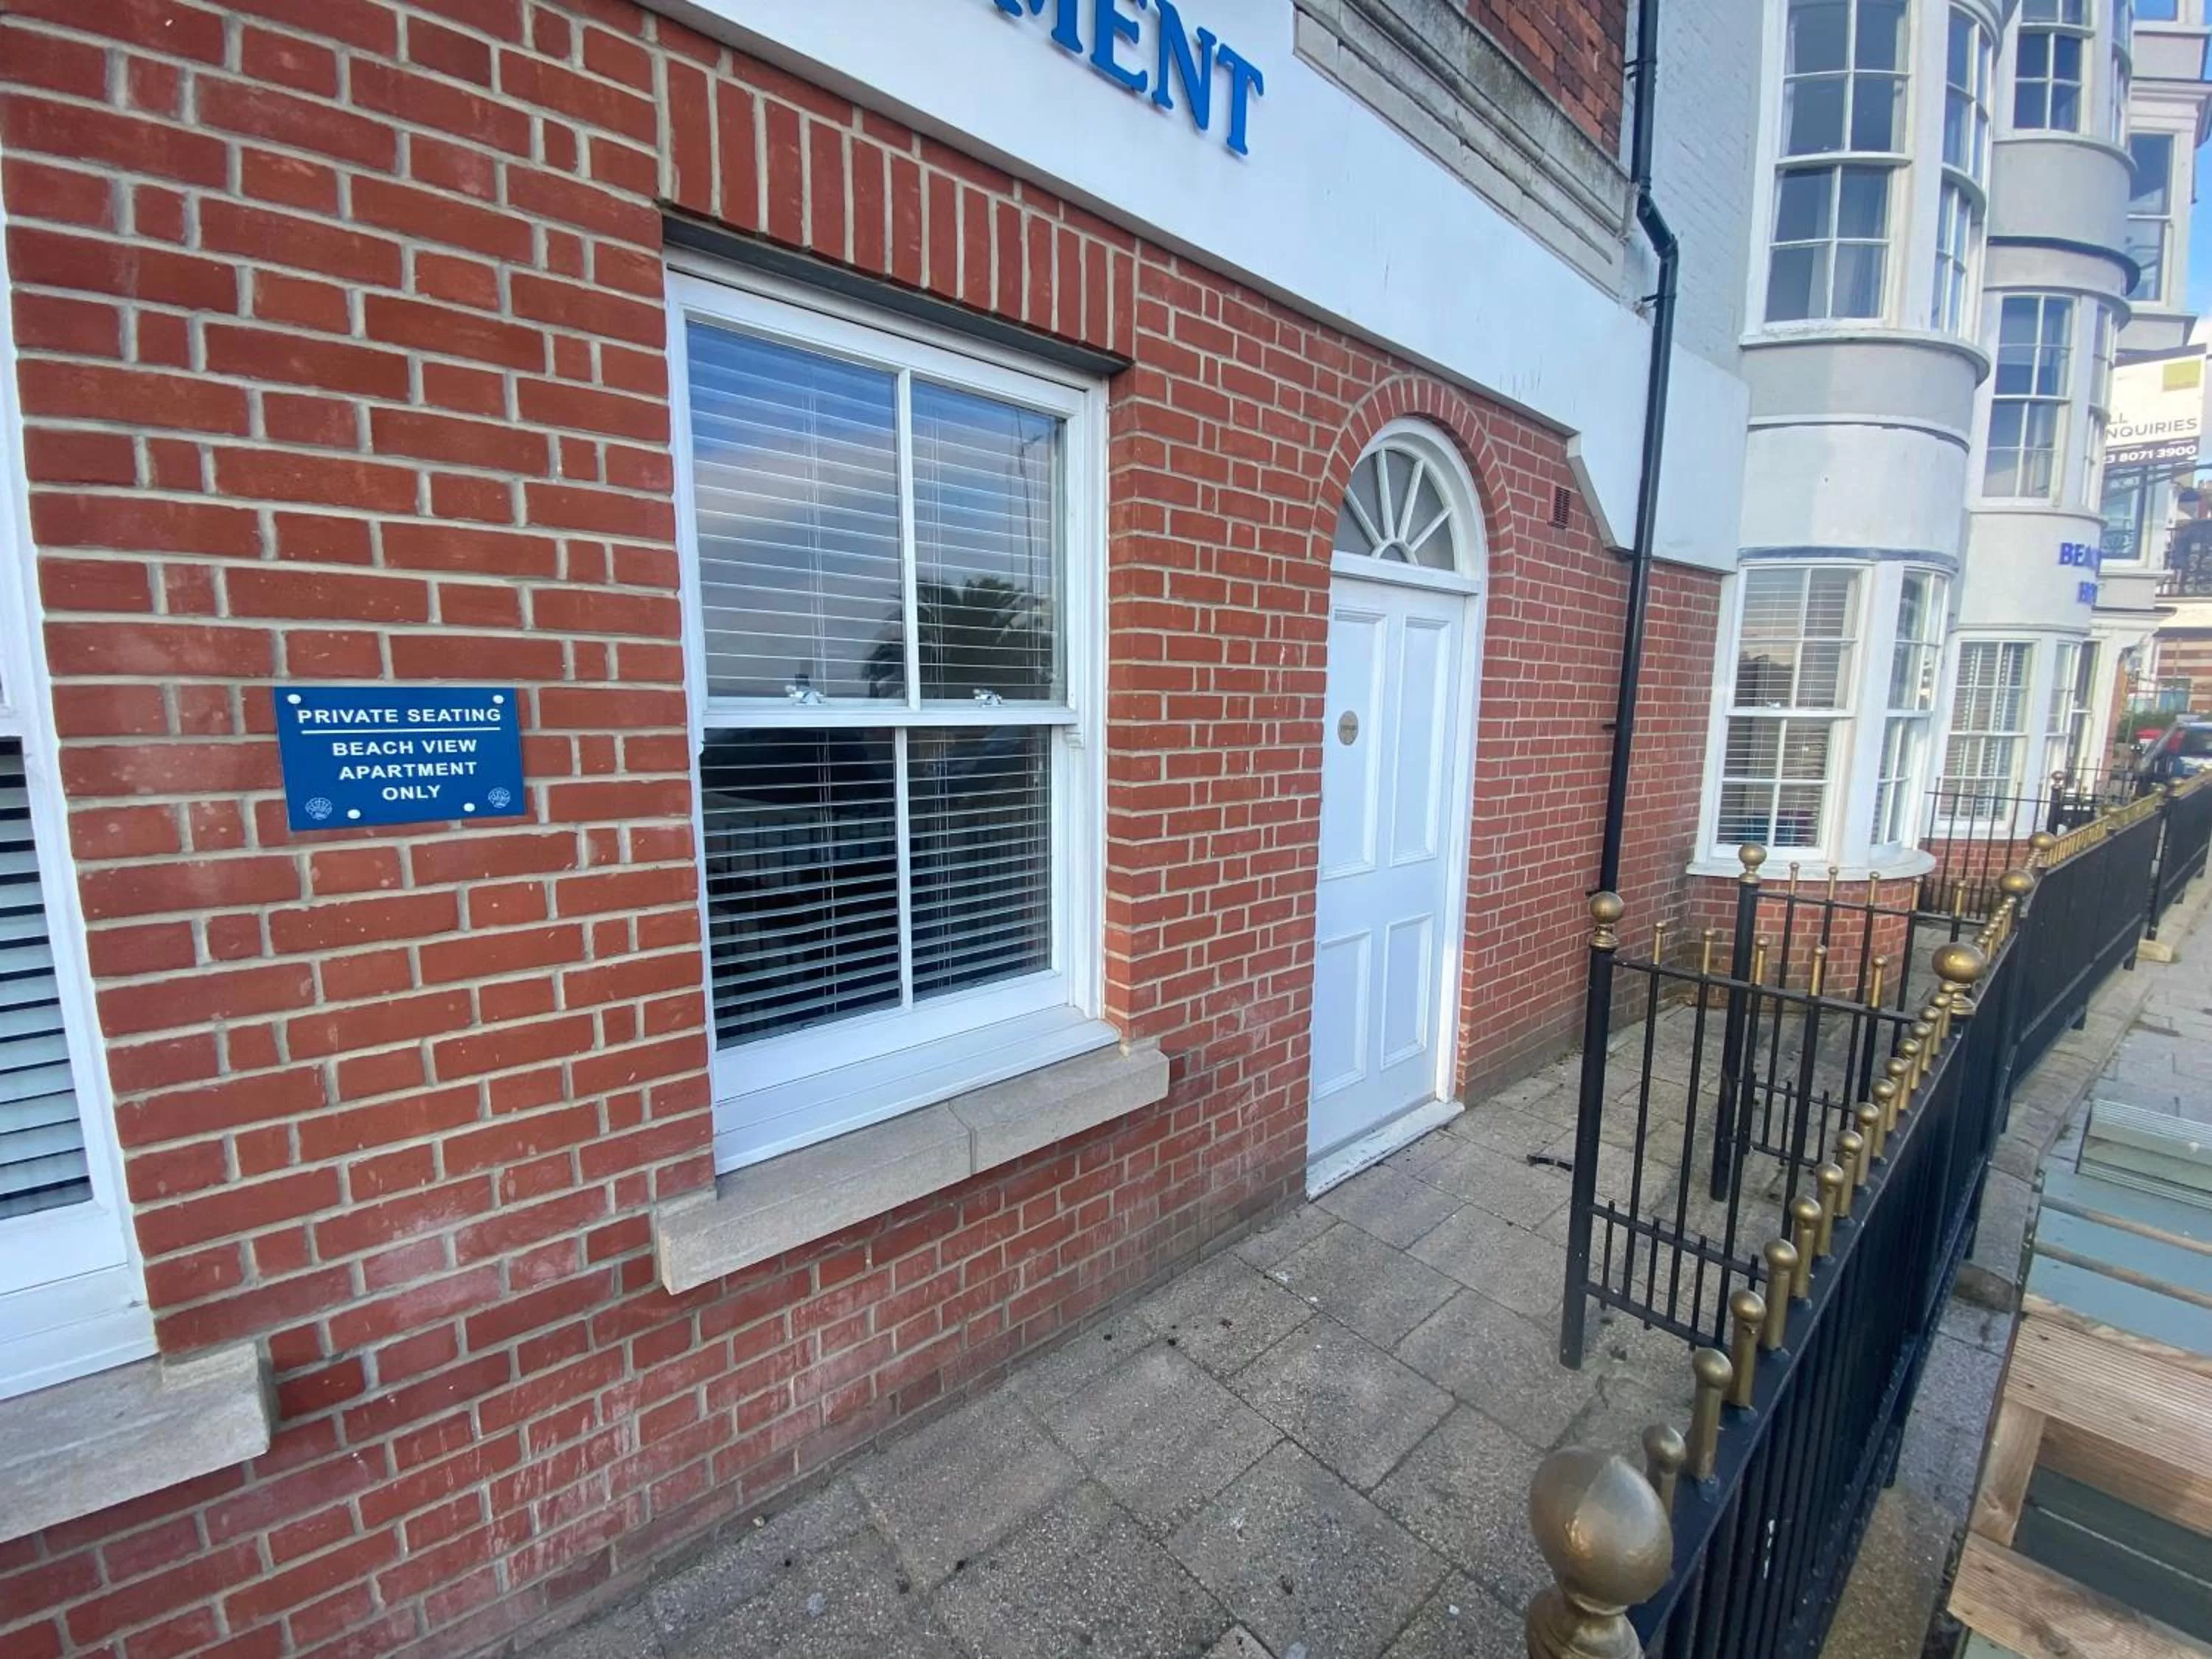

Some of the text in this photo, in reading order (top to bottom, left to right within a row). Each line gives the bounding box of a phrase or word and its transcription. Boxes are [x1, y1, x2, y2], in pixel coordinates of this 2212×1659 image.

[2119, 450, 2153, 463] 8071
[2156, 445, 2197, 459] 3900
[297, 708, 501, 723] PRIVATE SEATING
[332, 740, 477, 757] BEACH VIEW
[338, 762, 477, 780] APARTMENT
[382, 785, 441, 801] ONLY
